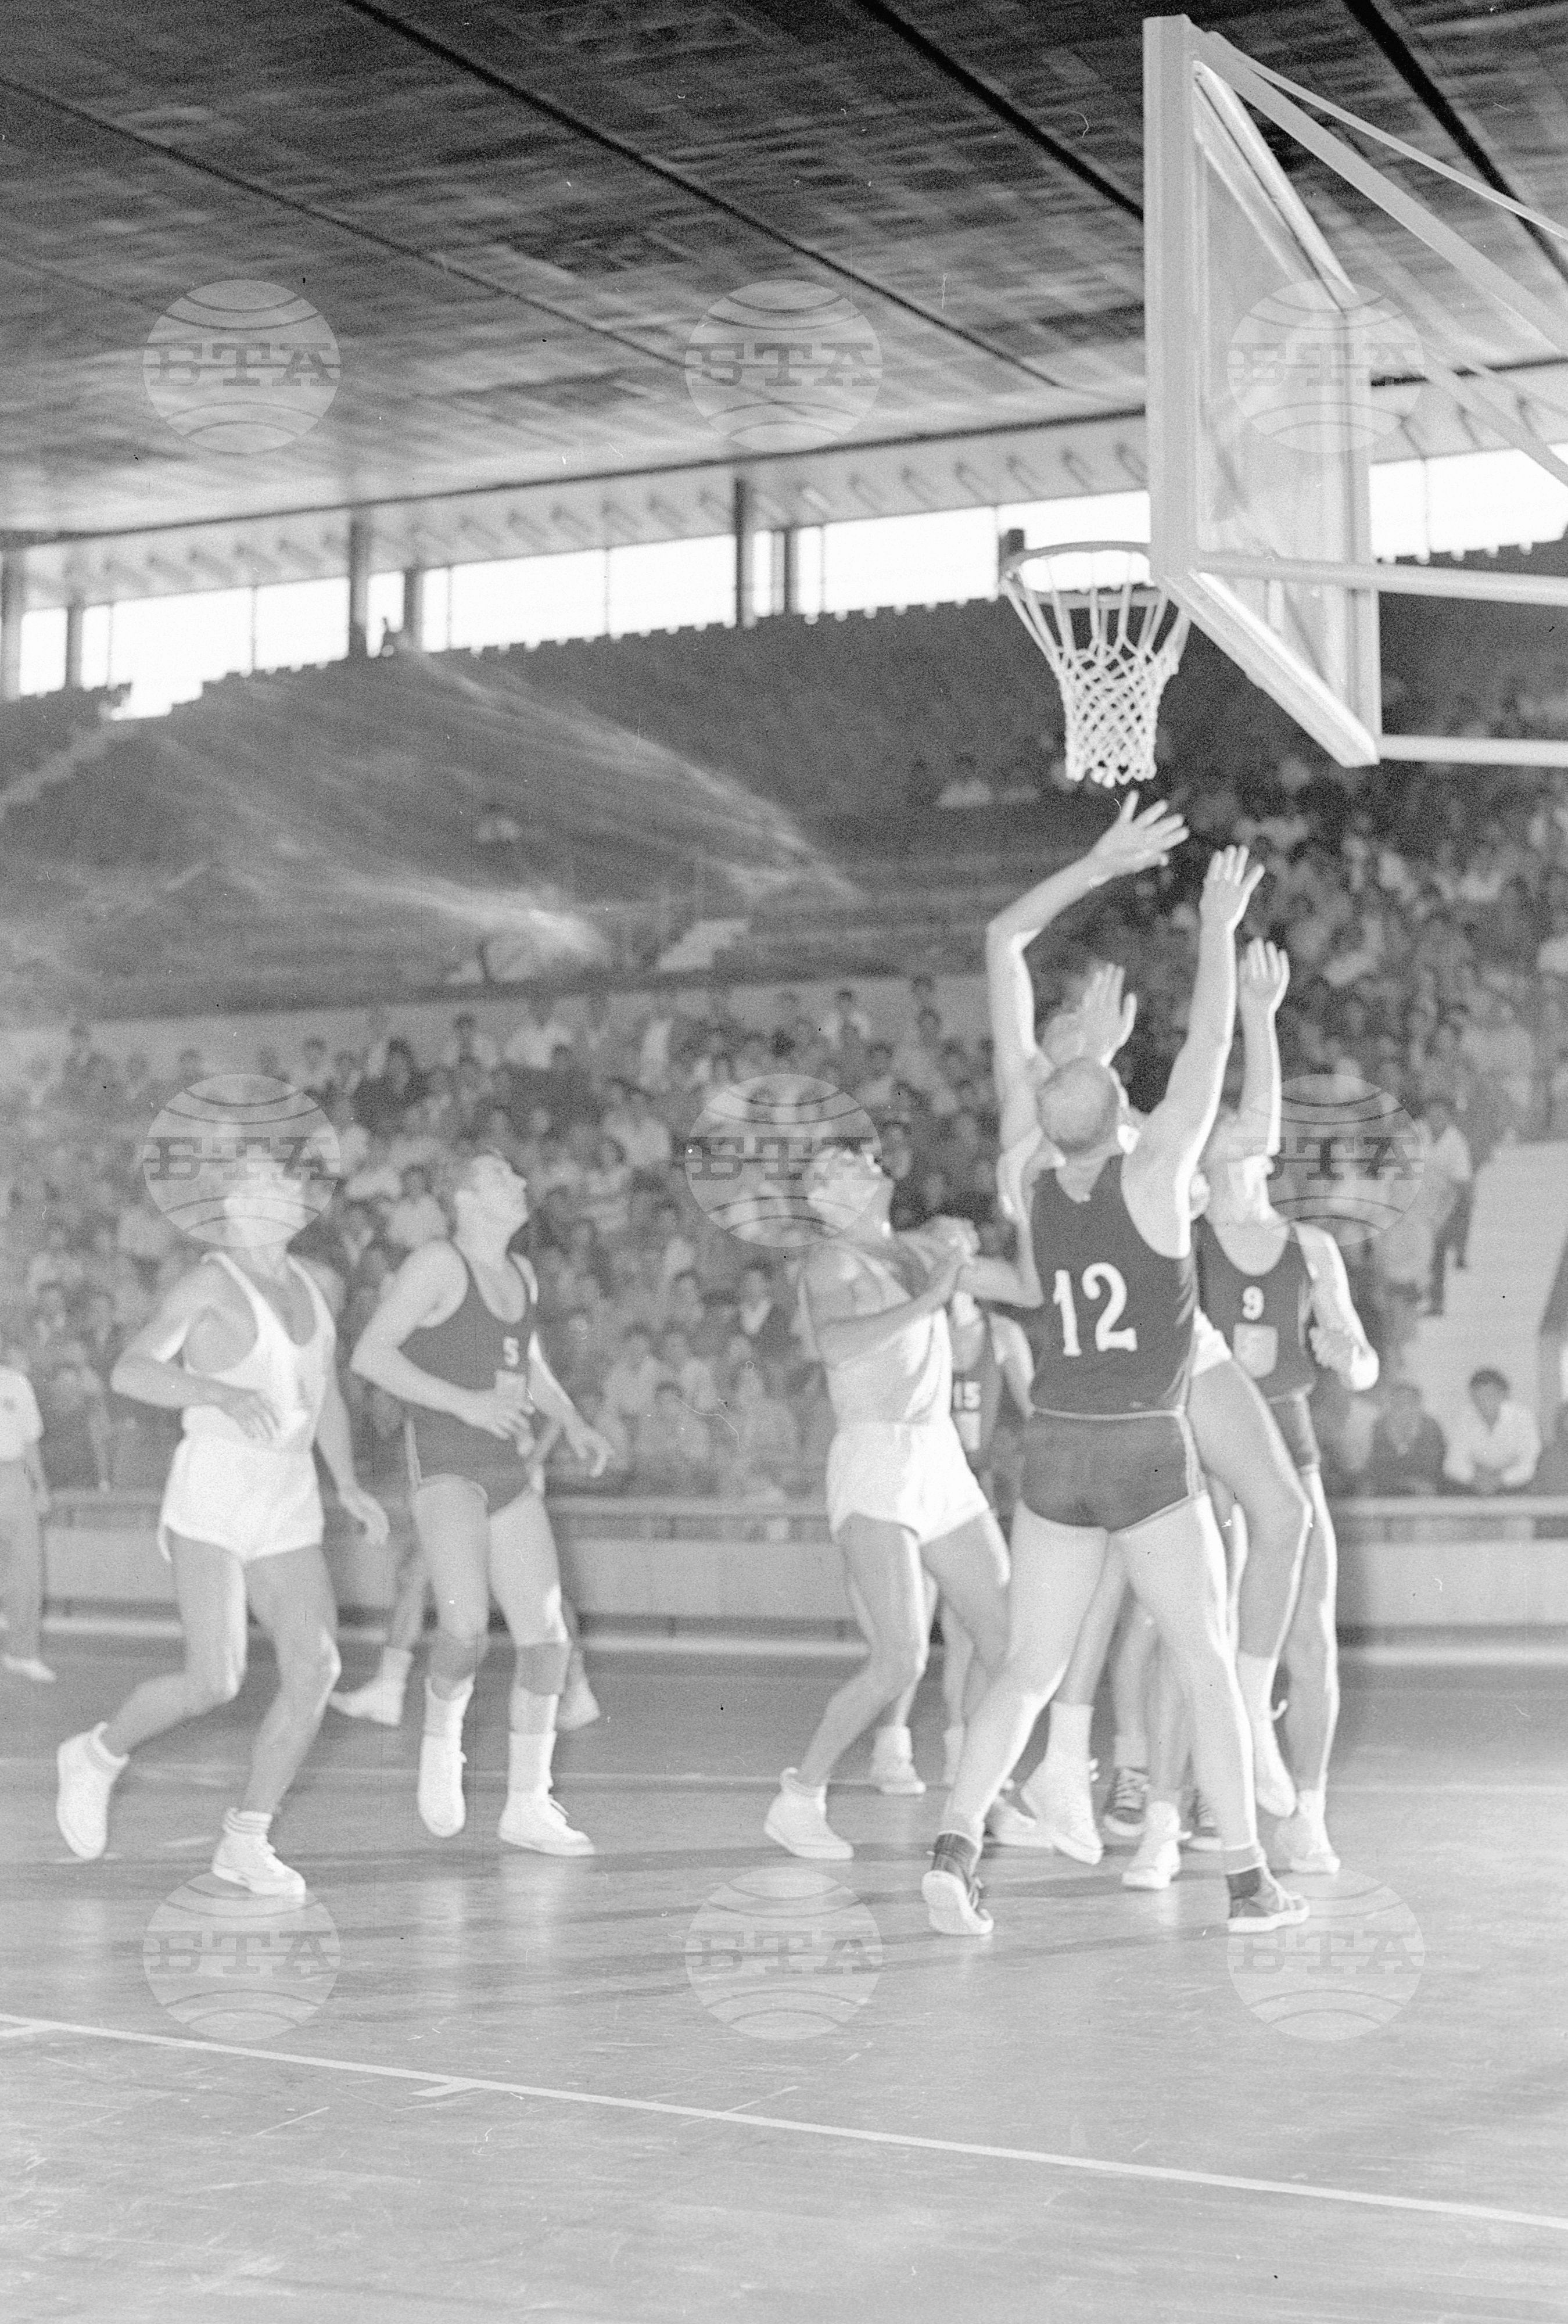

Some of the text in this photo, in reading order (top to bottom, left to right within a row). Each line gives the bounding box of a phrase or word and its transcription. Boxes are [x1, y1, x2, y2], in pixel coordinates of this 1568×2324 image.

[1052, 1262, 1138, 1357] 12
[1242, 1286, 1264, 1320] 9
[503, 1336, 519, 1365] 5
[953, 1381, 981, 1408] 15
